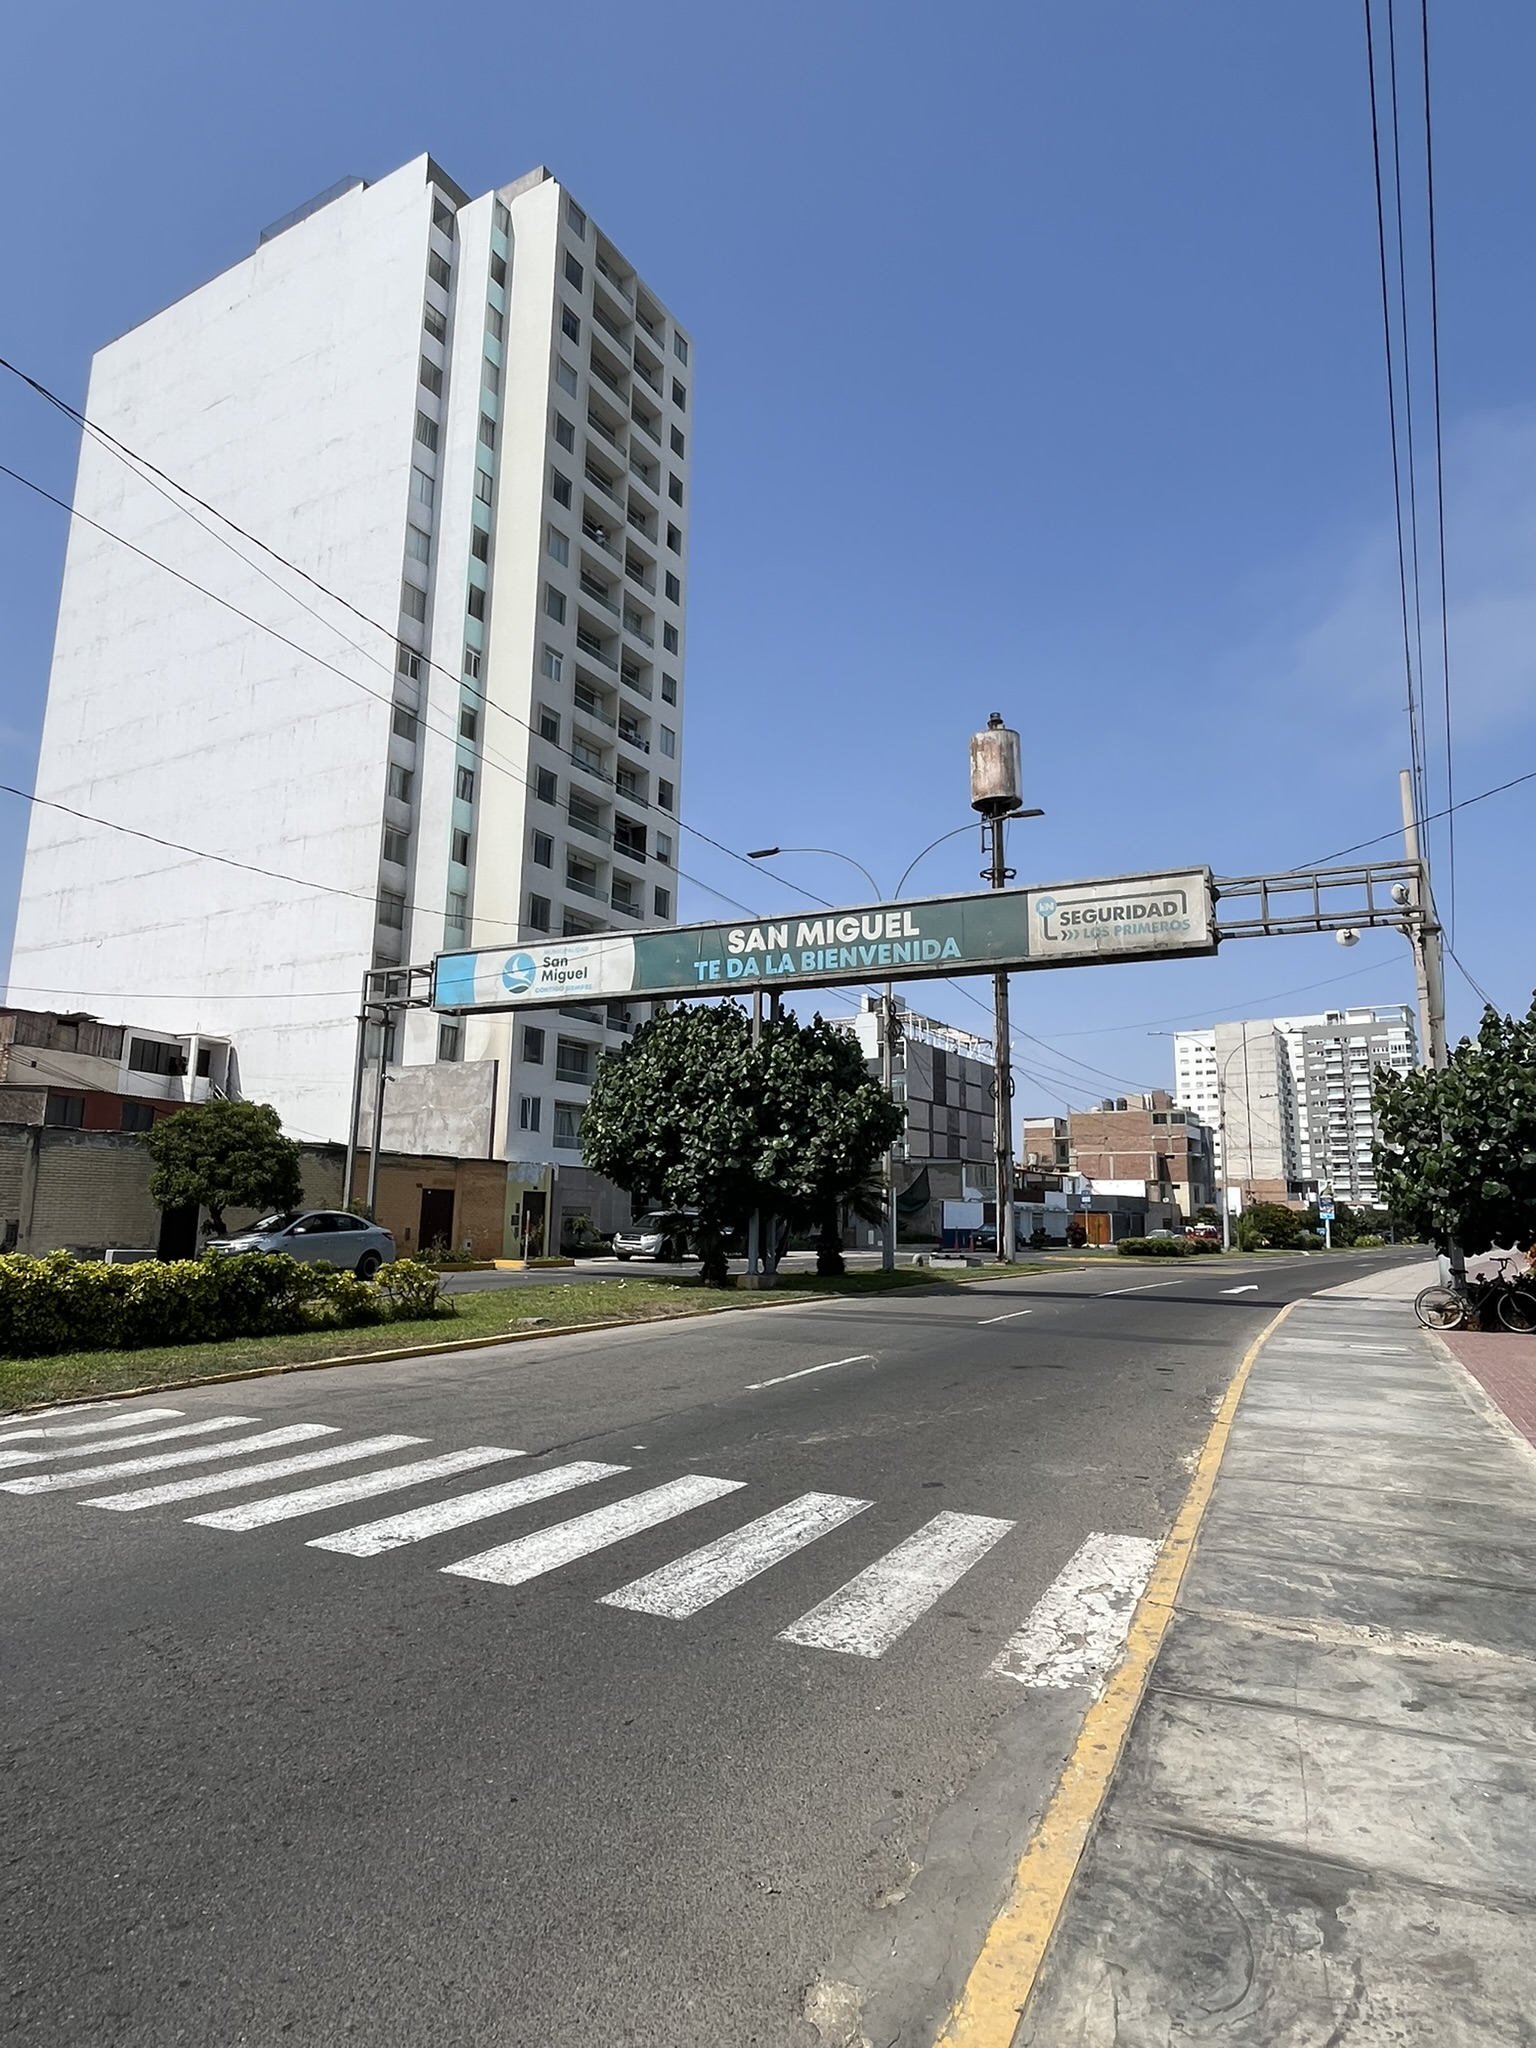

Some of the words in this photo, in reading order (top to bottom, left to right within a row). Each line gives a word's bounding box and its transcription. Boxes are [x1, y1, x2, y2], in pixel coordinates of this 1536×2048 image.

[1059, 901, 1178, 927] SEGURIDAD
[727, 924, 788, 954] SAN
[796, 911, 920, 948] MIGUEL
[1083, 925, 1110, 939] LOS
[1113, 919, 1191, 937] PRIMEROS
[543, 956, 568, 968] San
[694, 959, 721, 981] TE
[726, 957, 761, 978] DA
[765, 952, 796, 975] LA
[800, 936, 962, 971] BIENVENIDA
[541, 966, 588, 984] Miguel
